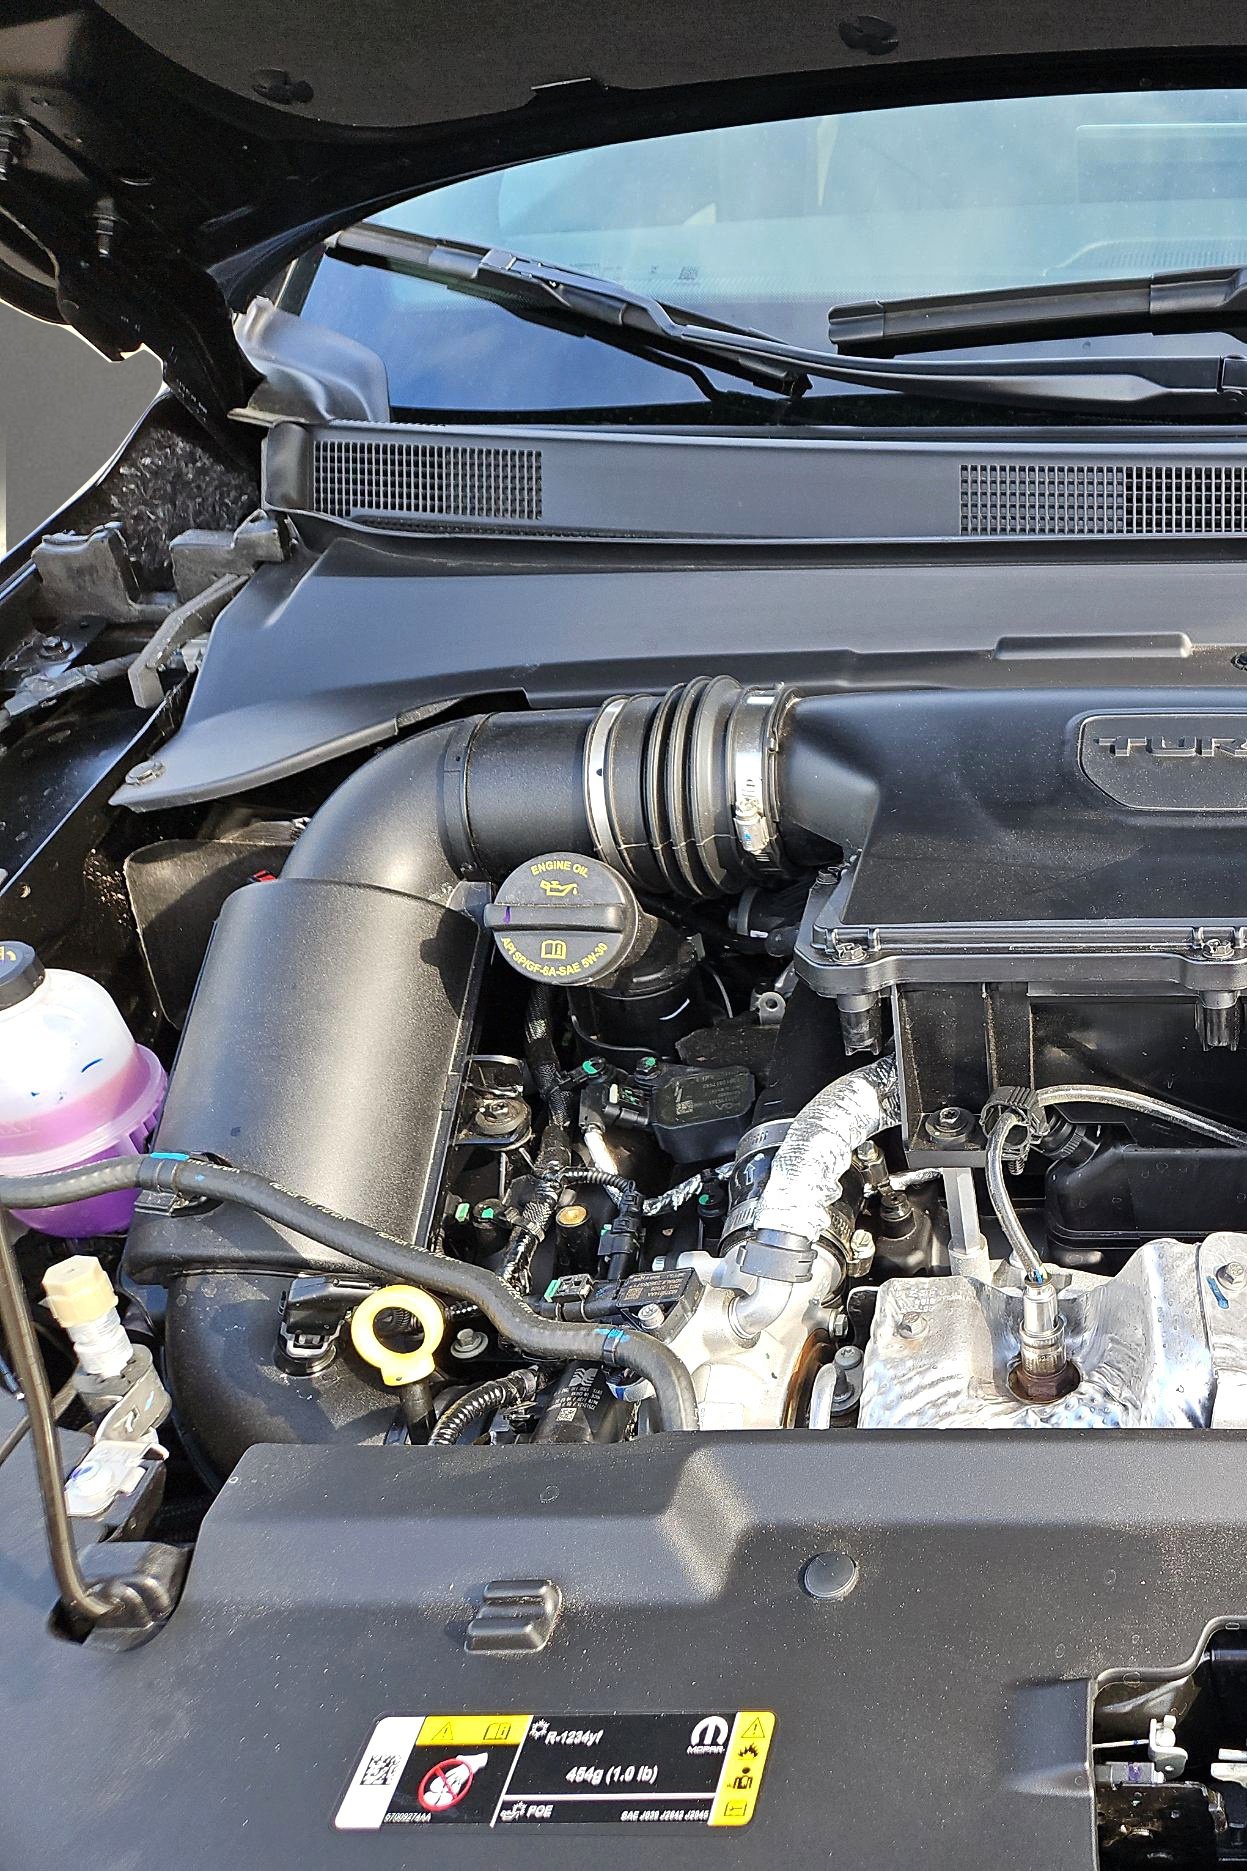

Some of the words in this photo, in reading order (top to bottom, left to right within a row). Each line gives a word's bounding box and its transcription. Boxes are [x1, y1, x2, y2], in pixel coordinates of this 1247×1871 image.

[531, 860, 572, 876] ENGINE
[572, 862, 590, 878] OIL
[501, 937, 514, 955] API
[580, 942, 609, 968] 5W-30
[565, 1766, 604, 1786] 454g
[605, 1766, 635, 1785] (1.0
[637, 1765, 659, 1784] lb)
[526, 1805, 553, 1819] POE
[620, 1810, 640, 1821] SAE
